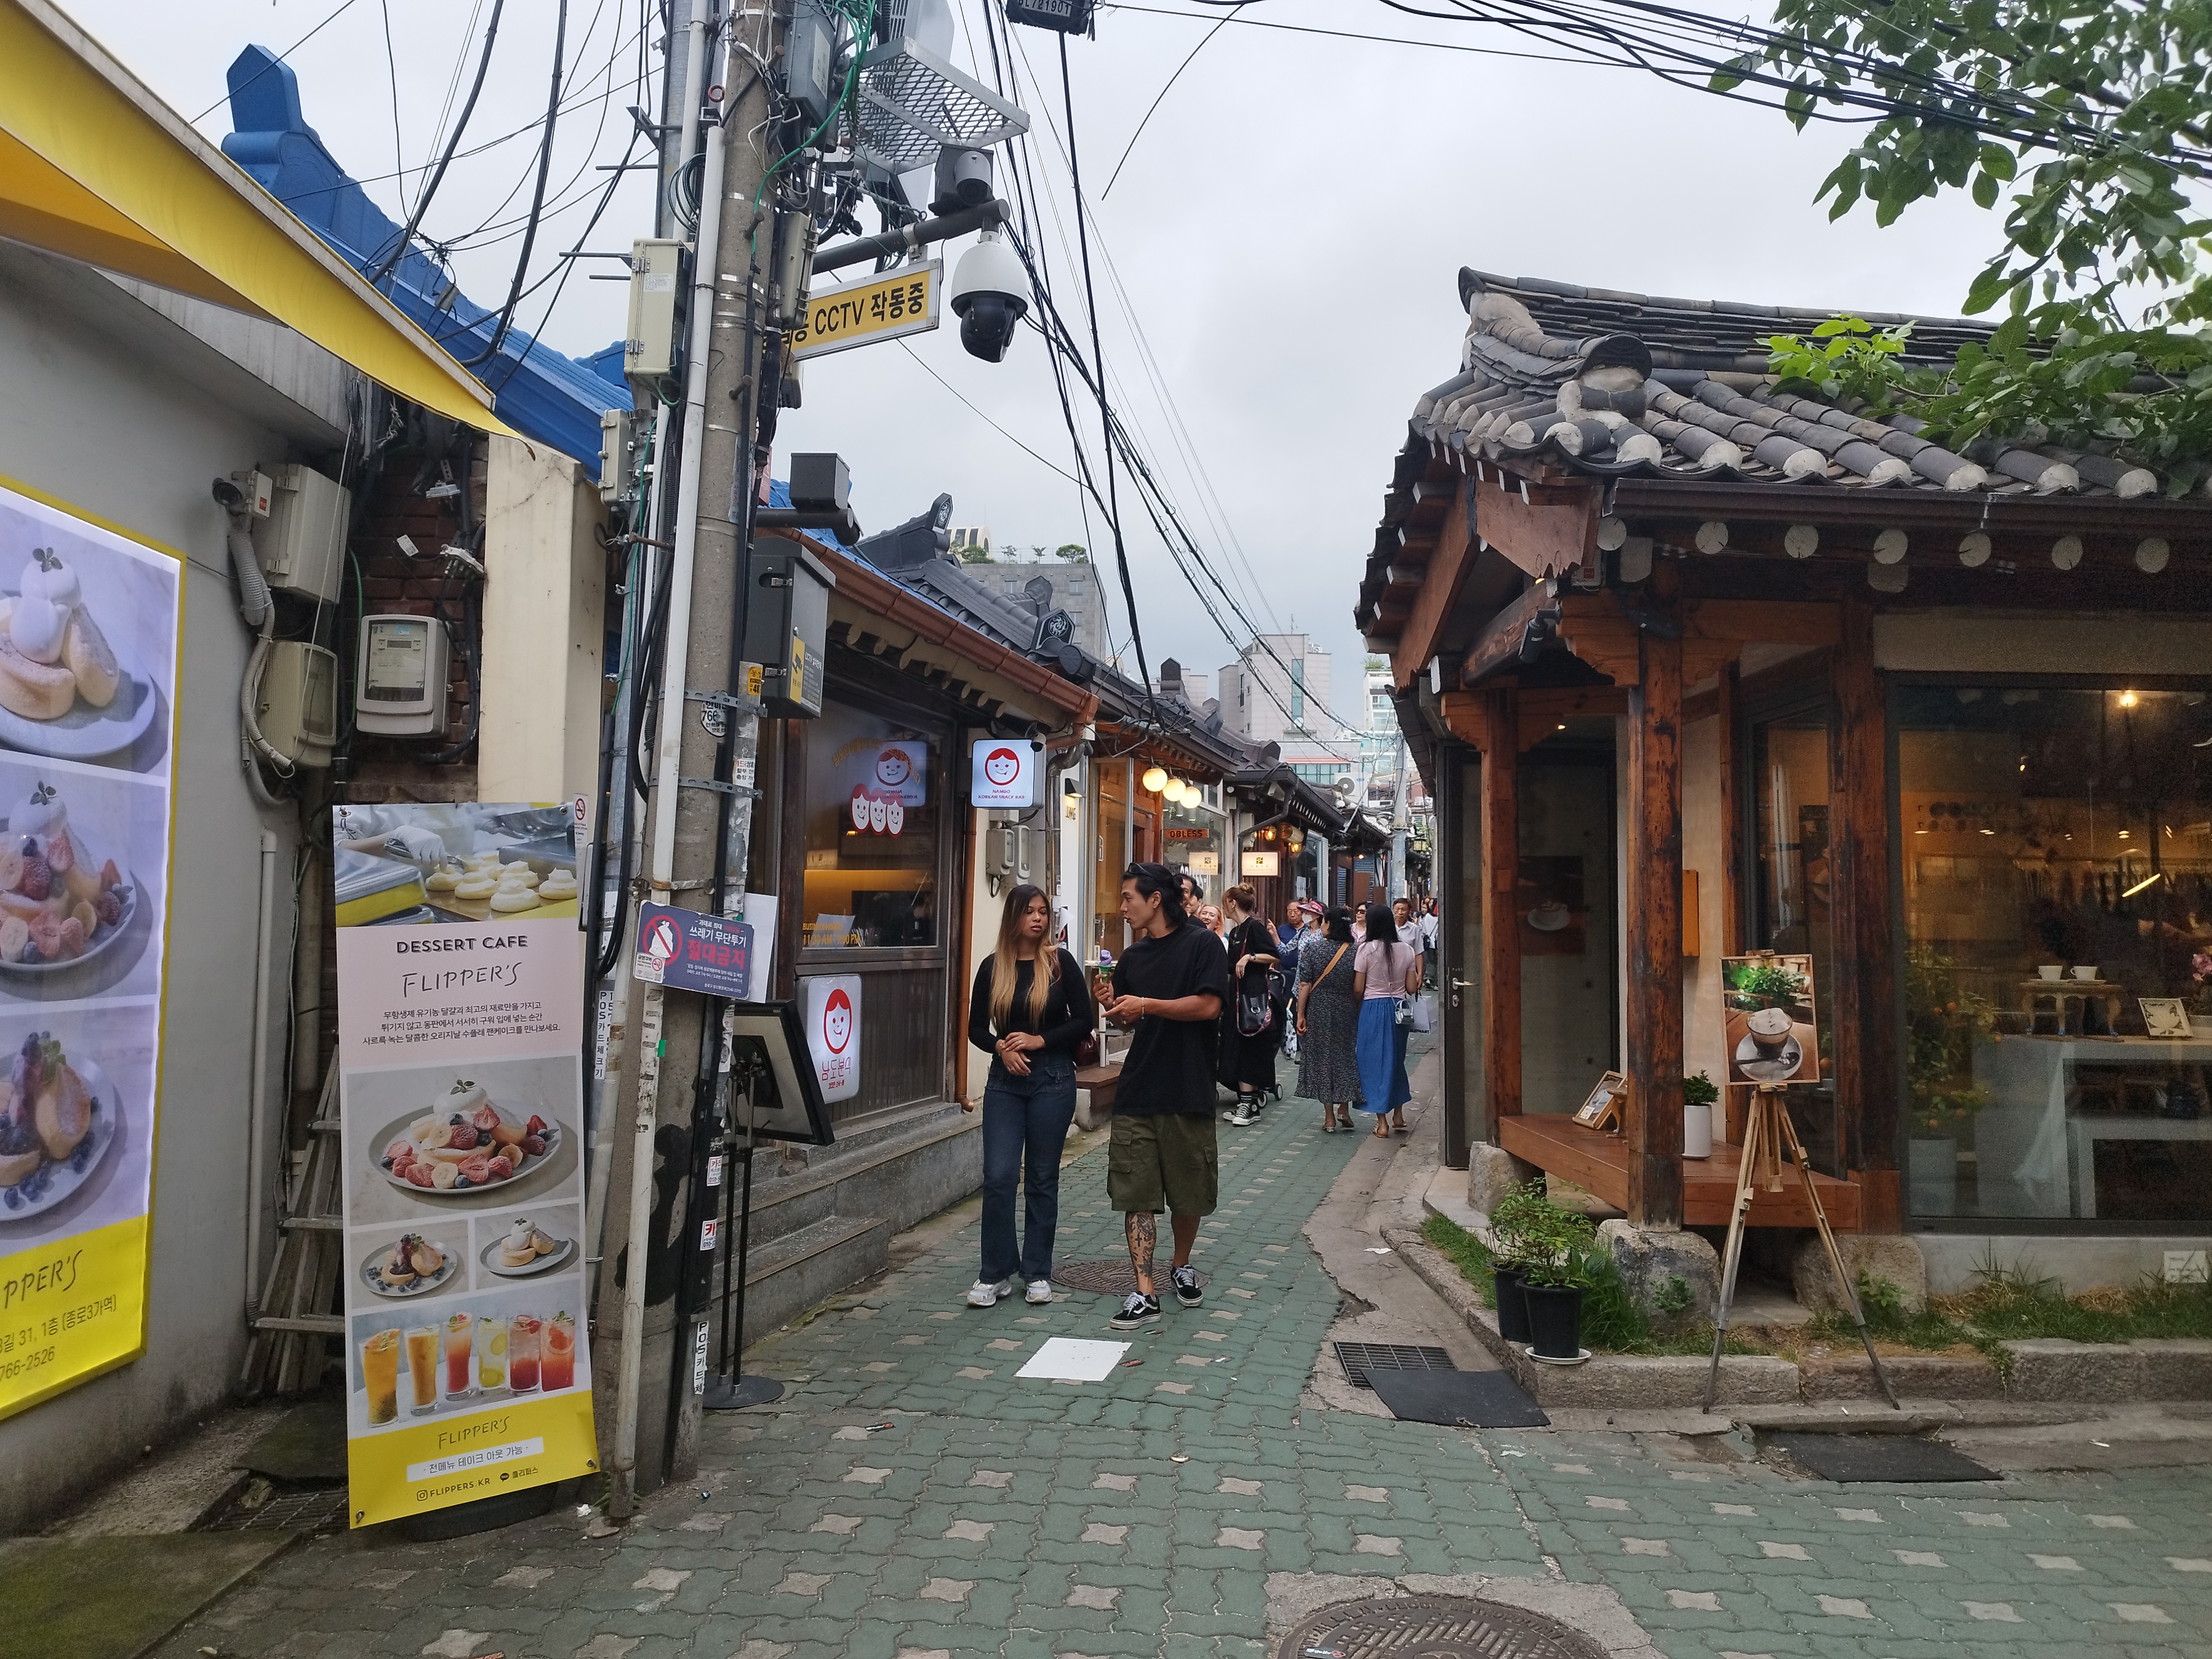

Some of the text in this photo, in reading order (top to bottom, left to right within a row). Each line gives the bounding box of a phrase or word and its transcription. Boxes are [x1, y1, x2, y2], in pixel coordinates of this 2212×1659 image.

[815, 299, 864, 335] CCTV
[871, 281, 924, 322] 작동중
[1170, 830, 1202, 838] OBLESS
[397, 936, 528, 953] DESSERT CAFE
[688, 925, 747, 948] 쓰레기 무단투기
[687, 939, 745, 969] 절대금지
[402, 962, 523, 998] FLIPPER'S
[383, 1001, 542, 1020] 무항생제 유기농 달걀과 최고의 재료만을 가지고
[381, 1013, 542, 1032] 튀기지 않고 동판에서 서서히 구워 입에 넣는 순간
[362, 1036, 387, 1045] 사르륵
[388, 1035, 404, 1044] 녹는
[405, 1032, 429, 1043] 달콤한
[486, 1026, 523, 1036] 팬케이크를
[524, 1024, 560, 1034] 만나보세요.
[821, 1056, 851, 1081] 남도분식
[19, 1327, 37, 1345] 31,
[42, 1317, 58, 1336] 1층
[62, 1295, 116, 1331] (종로3가역)
[438, 1415, 510, 1449] FLIPPER'S
[429, 1446, 523, 1474] 전메뉴 테이크 아웃 가능
[512, 1467, 539, 1479] 플리퍼스
[430, 1477, 491, 1498] FLIPPERS.KR
